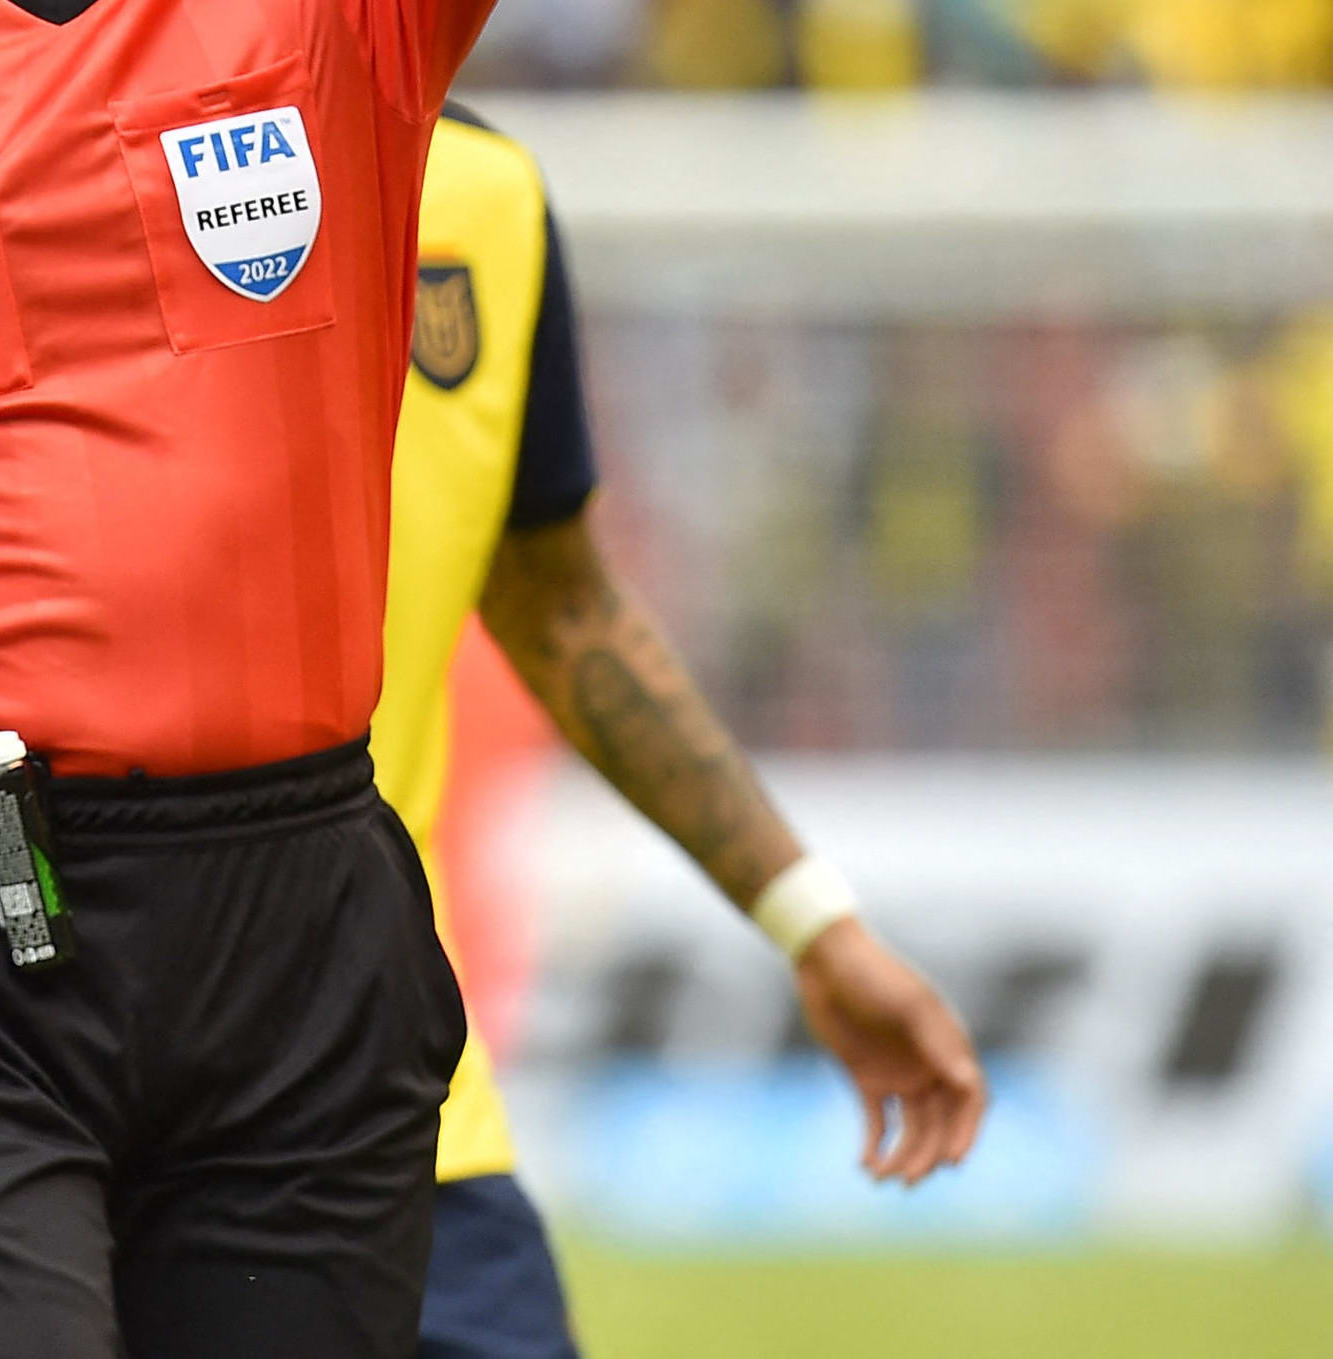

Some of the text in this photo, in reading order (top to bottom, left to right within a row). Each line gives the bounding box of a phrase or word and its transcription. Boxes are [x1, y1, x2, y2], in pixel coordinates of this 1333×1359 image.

[178, 121, 296, 179] FIFA
[196, 189, 309, 231] REFEREE
[238, 256, 290, 286] 2022
